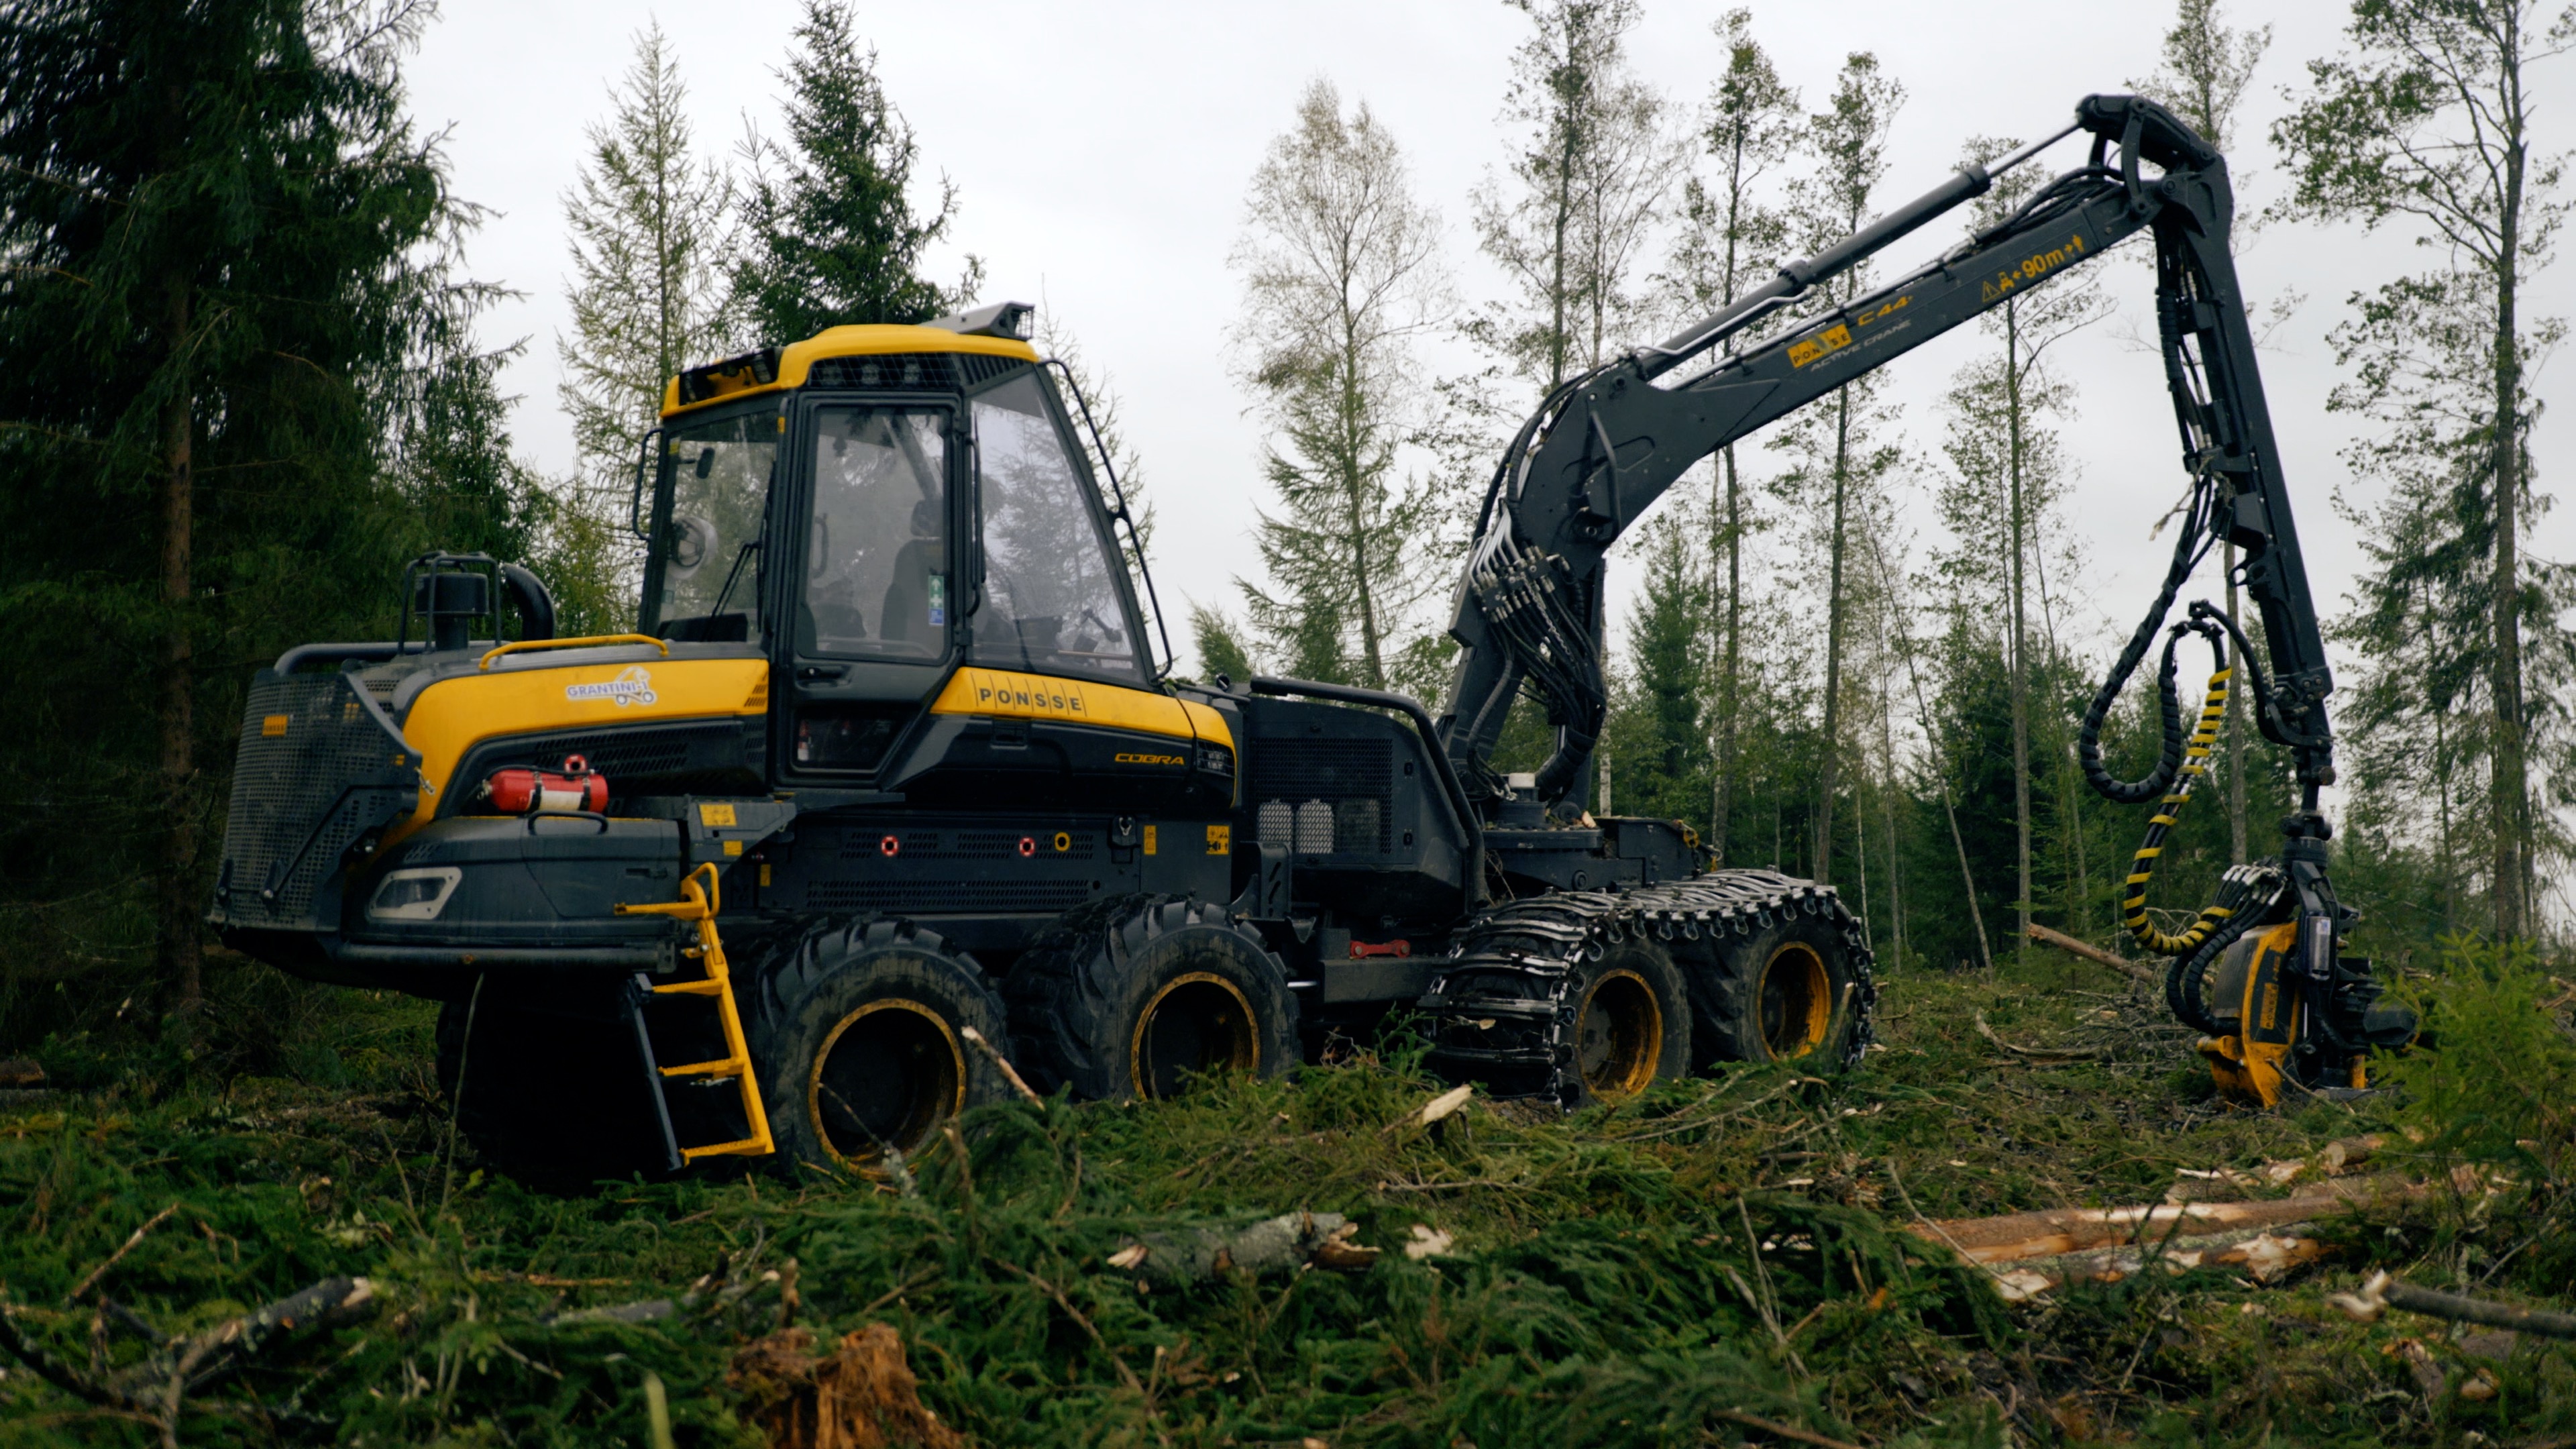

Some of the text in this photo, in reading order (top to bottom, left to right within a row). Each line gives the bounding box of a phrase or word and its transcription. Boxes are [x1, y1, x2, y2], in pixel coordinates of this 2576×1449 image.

[2022, 249, 2065, 278] 90m
[1793, 333, 1849, 364] PONSE
[1811, 319, 1911, 372] ACTIVE CRANE
[979, 688, 1082, 711] PONSSE
[1114, 753, 1185, 765] COBRA
